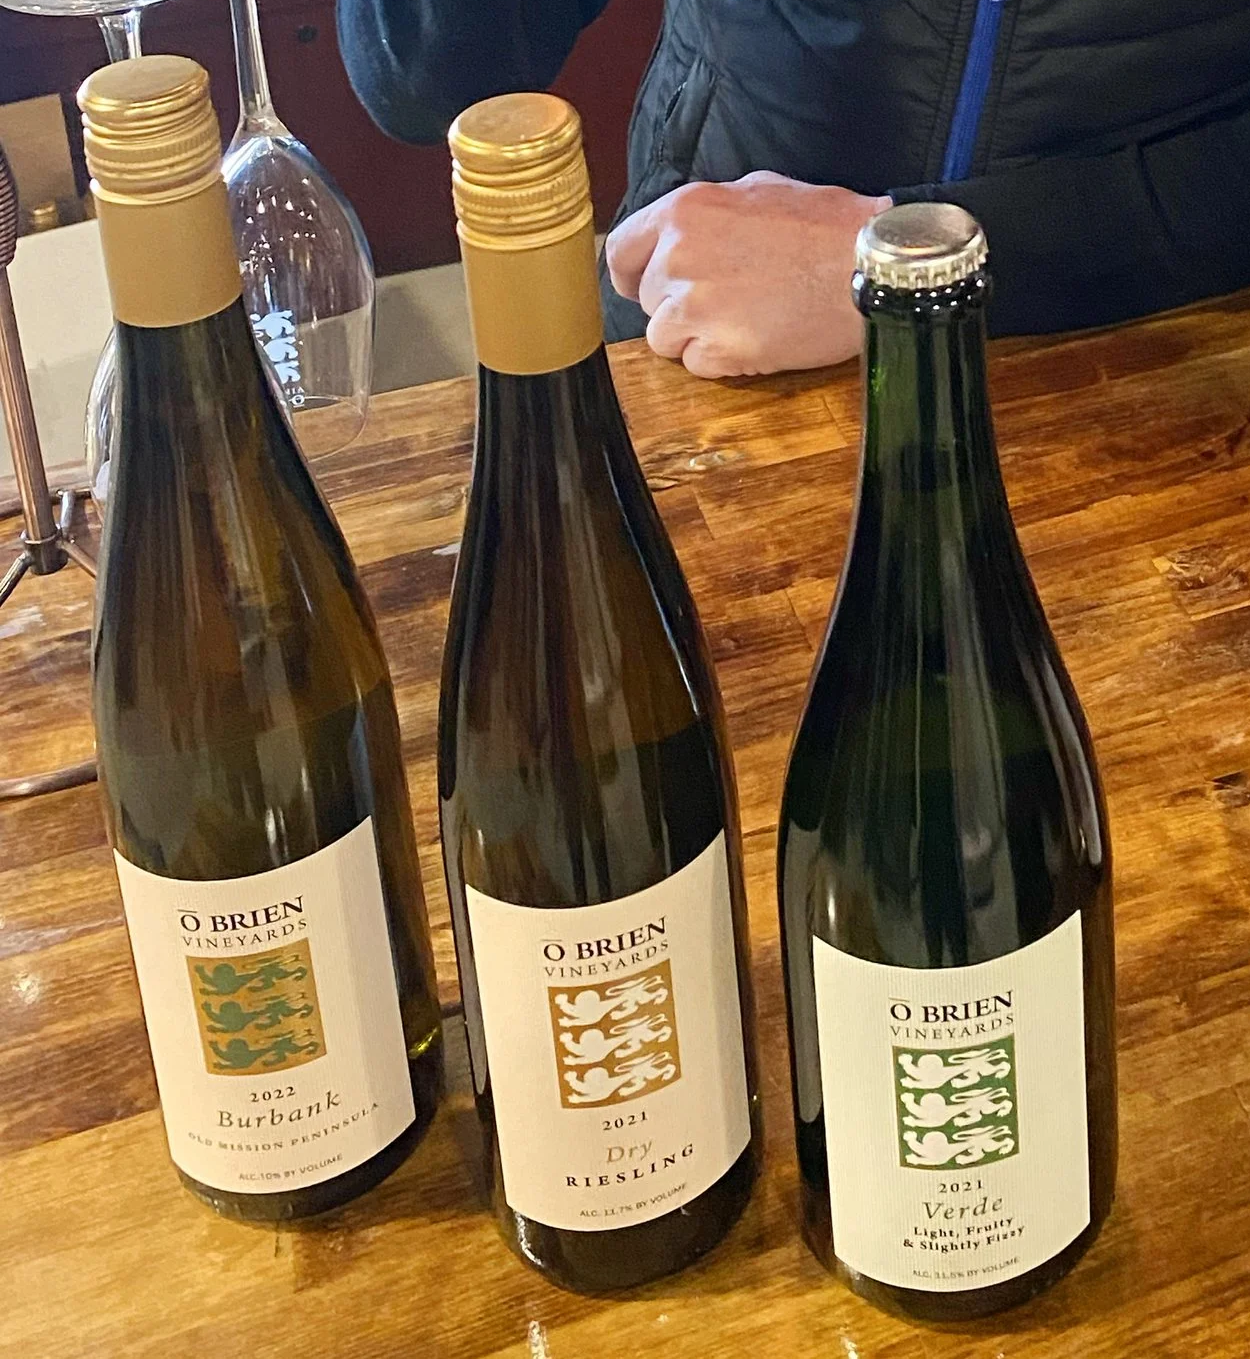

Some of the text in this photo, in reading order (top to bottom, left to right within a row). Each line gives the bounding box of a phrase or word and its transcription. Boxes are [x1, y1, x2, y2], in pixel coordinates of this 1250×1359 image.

[210, 895, 304, 932] BRIEN
[182, 918, 307, 949] VINEYARDS
[576, 915, 667, 961] BRIEN
[543, 939, 670, 978] VINEYARDS
[921, 990, 1014, 1024] BRIEN
[890, 1013, 1014, 1040] VINEYARDS
[250, 1086, 296, 1103] 2022
[217, 1091, 342, 1129] Burbank
[602, 1111, 648, 1131] 2021
[188, 1102, 379, 1153] OLD MISSION PENINSULA
[300, 1153, 342, 1174] VOLUME
[606, 1140, 653, 1163] Dry
[566, 1143, 694, 1188] RIESLING
[636, 1201, 648, 1209] BY
[650, 1182, 687, 1204] VOLUME
[938, 1179, 984, 1194] 2021
[924, 1196, 1003, 1220] Verde
[903, 1226, 1024, 1253] & Slightly Fizzy
[914, 1218, 1013, 1240] Light, Fruity
[982, 1257, 1020, 1273] VOLUME
